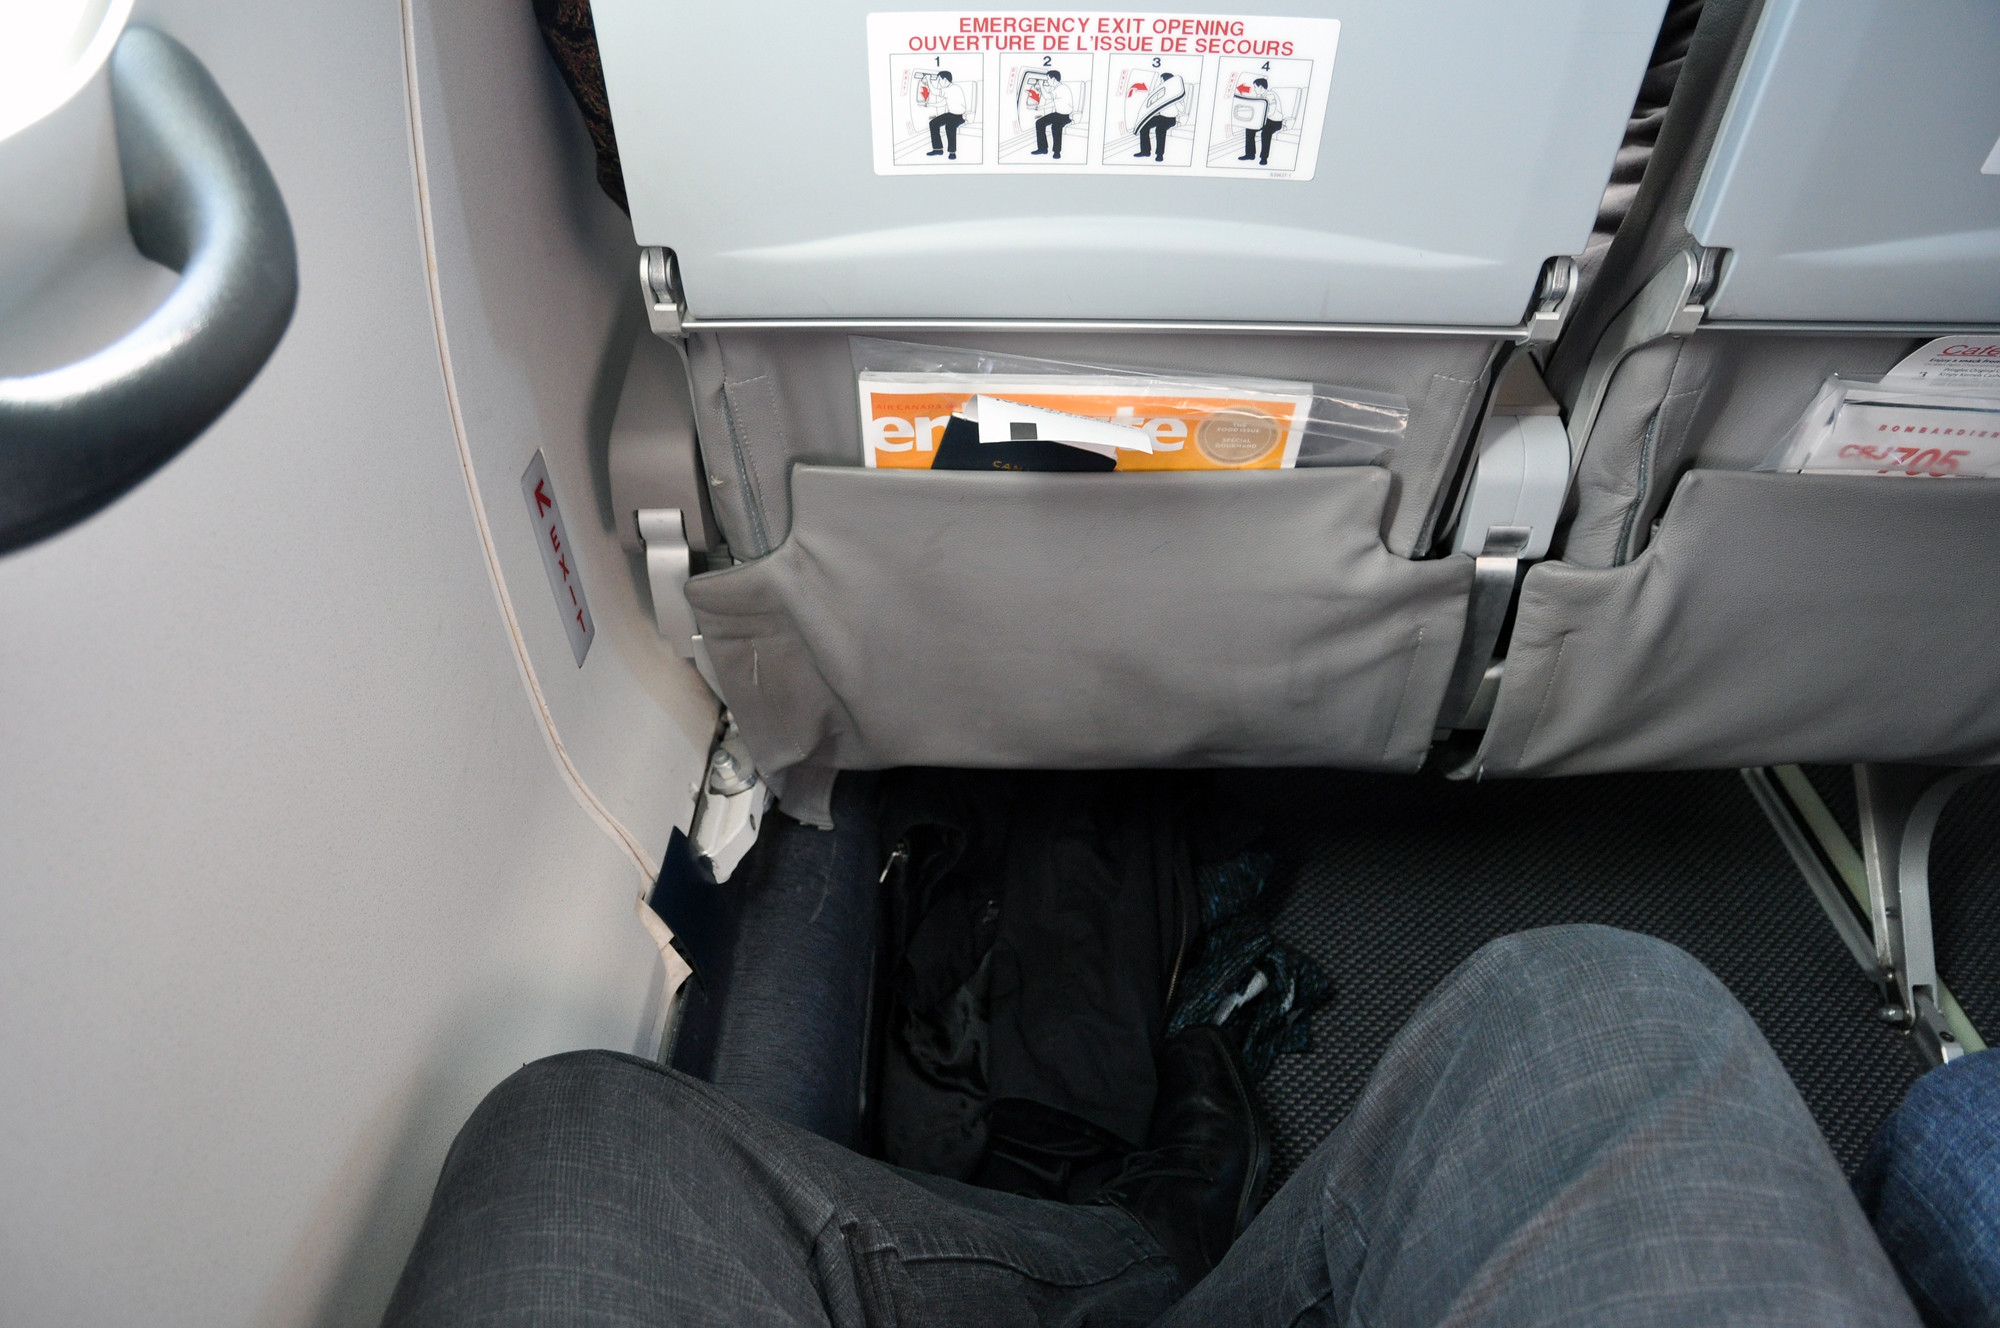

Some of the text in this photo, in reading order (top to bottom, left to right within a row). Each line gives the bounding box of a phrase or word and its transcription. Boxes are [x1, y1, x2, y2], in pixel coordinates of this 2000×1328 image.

[959, 17, 1245, 36] EMERGENCY EXIT OPENING
[908, 35, 1294, 57] OUVERTURE DE L'ISSUE DE SECOURS
[934, 56, 940, 67] 1
[1043, 55, 1052, 67] 2
[1152, 57, 1162, 68] 3
[1261, 60, 1271, 72] 4
[896, 403, 942, 411] CANADA
[1878, 424, 2000, 438] BOMBARDIER
[992, 460, 1030, 471] CAN
[550, 525, 586, 633] EXIT
